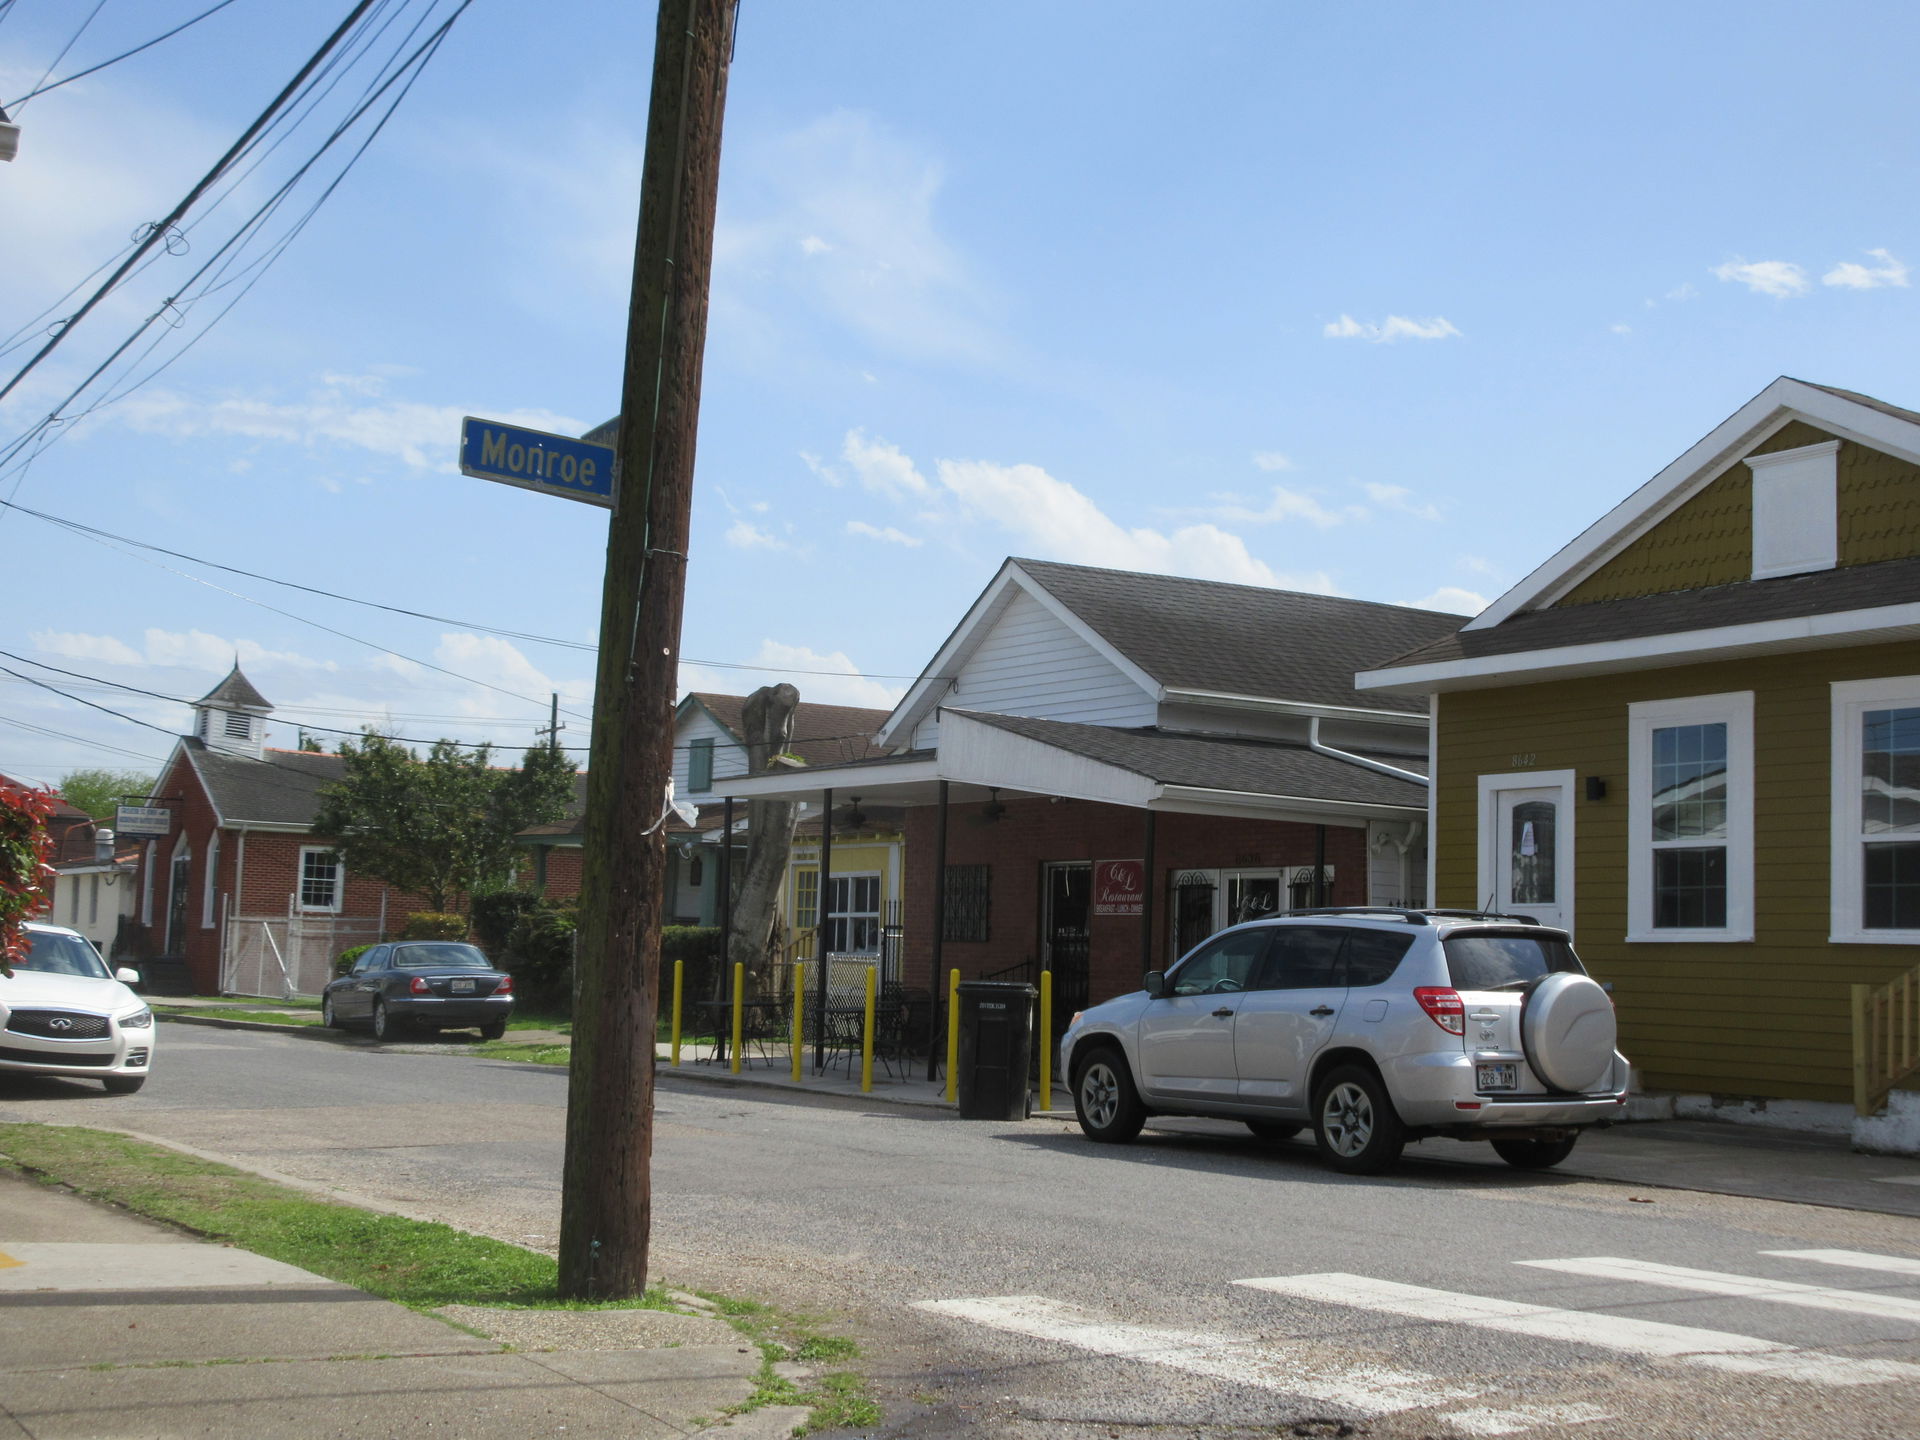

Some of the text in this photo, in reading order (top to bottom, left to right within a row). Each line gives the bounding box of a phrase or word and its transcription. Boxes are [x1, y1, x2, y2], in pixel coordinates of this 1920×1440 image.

[481, 429, 596, 486] Monroe
[1512, 753, 1536, 768] 8642
[1100, 888, 1143, 903] Restaurant
